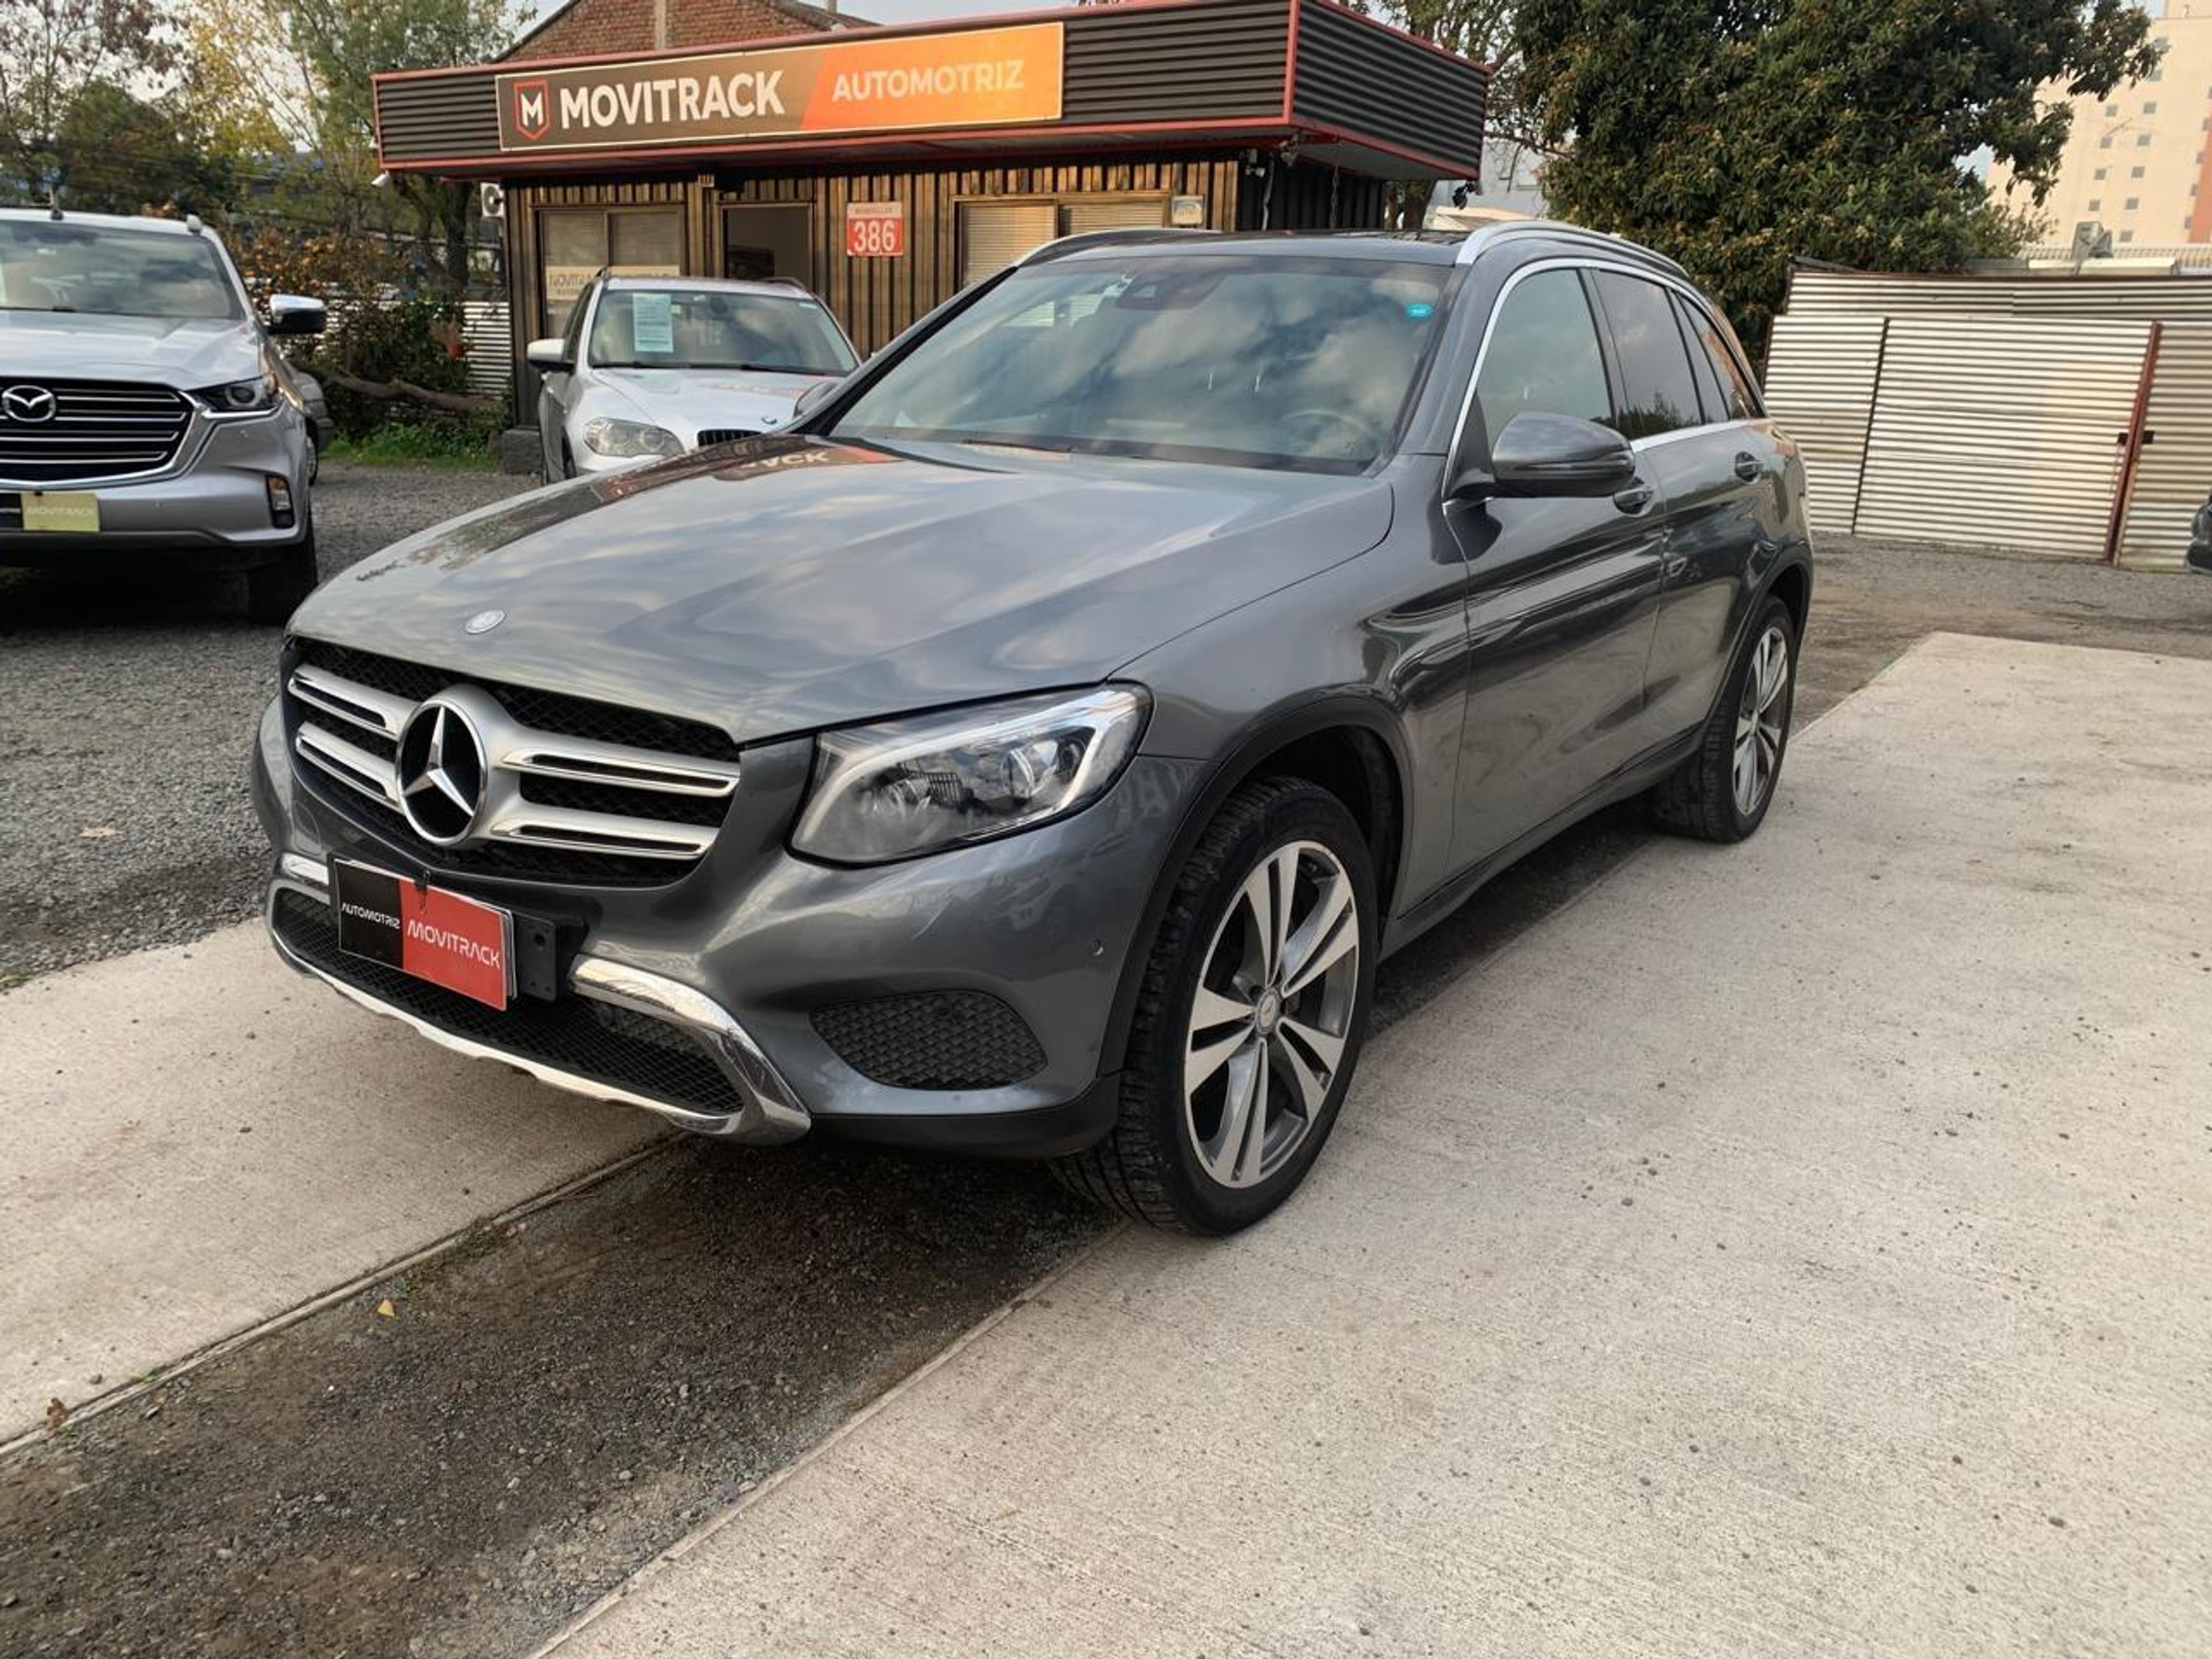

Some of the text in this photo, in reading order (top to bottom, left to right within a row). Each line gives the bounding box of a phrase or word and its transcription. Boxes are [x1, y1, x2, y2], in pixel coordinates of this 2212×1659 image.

[560, 59, 1024, 129] MOVITRACK AUTOMOTRIZ
[854, 220, 895, 252] 386
[342, 902, 501, 969] AUTOMOTRIZ MOVITRACK
